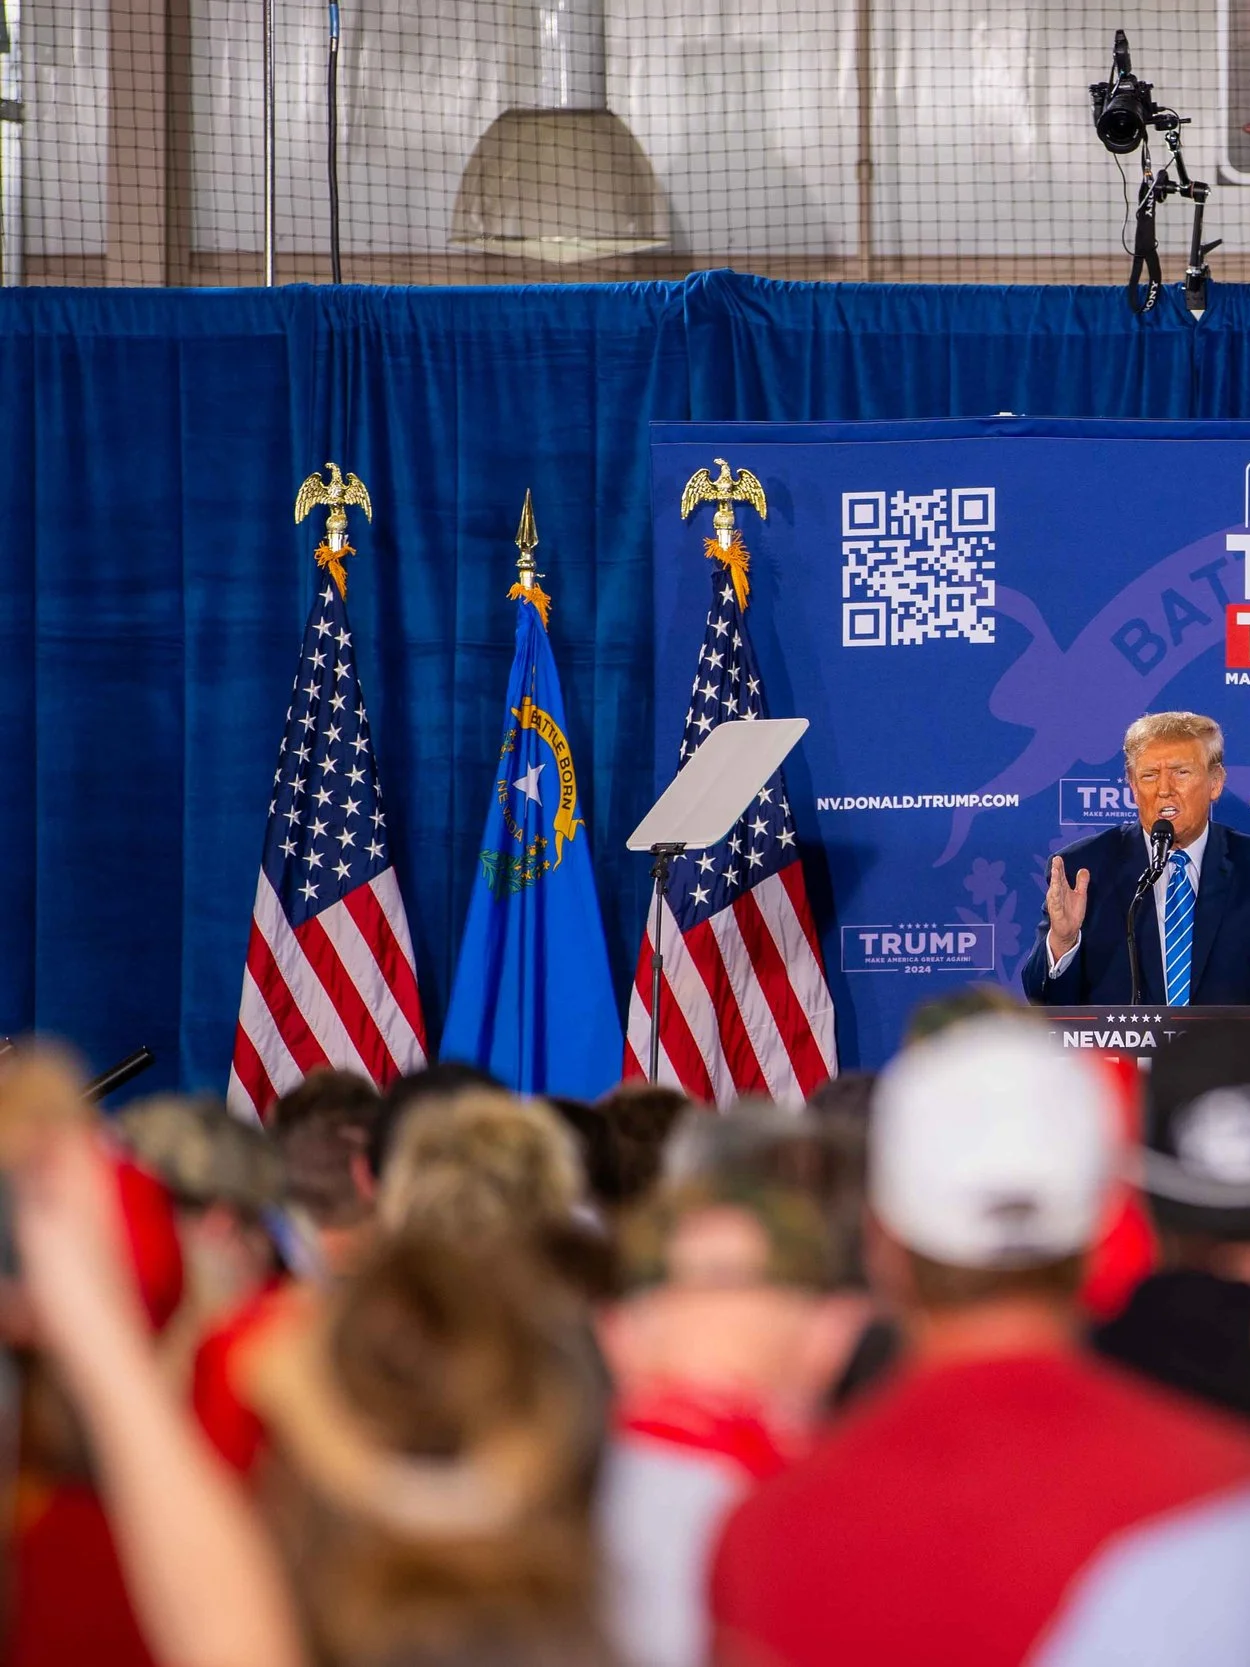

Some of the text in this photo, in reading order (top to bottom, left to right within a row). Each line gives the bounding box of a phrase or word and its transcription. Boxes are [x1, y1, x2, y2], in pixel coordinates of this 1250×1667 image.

[1145, 190, 1155, 217] ONY
[560, 756, 574, 811] BORN
[817, 794, 1019, 811] NV.DONALDJTRUMP.COM
[1077, 787, 1139, 809] TRU
[859, 932, 977, 955] TRUMP
[1063, 1031, 1157, 1048] NEVADA
